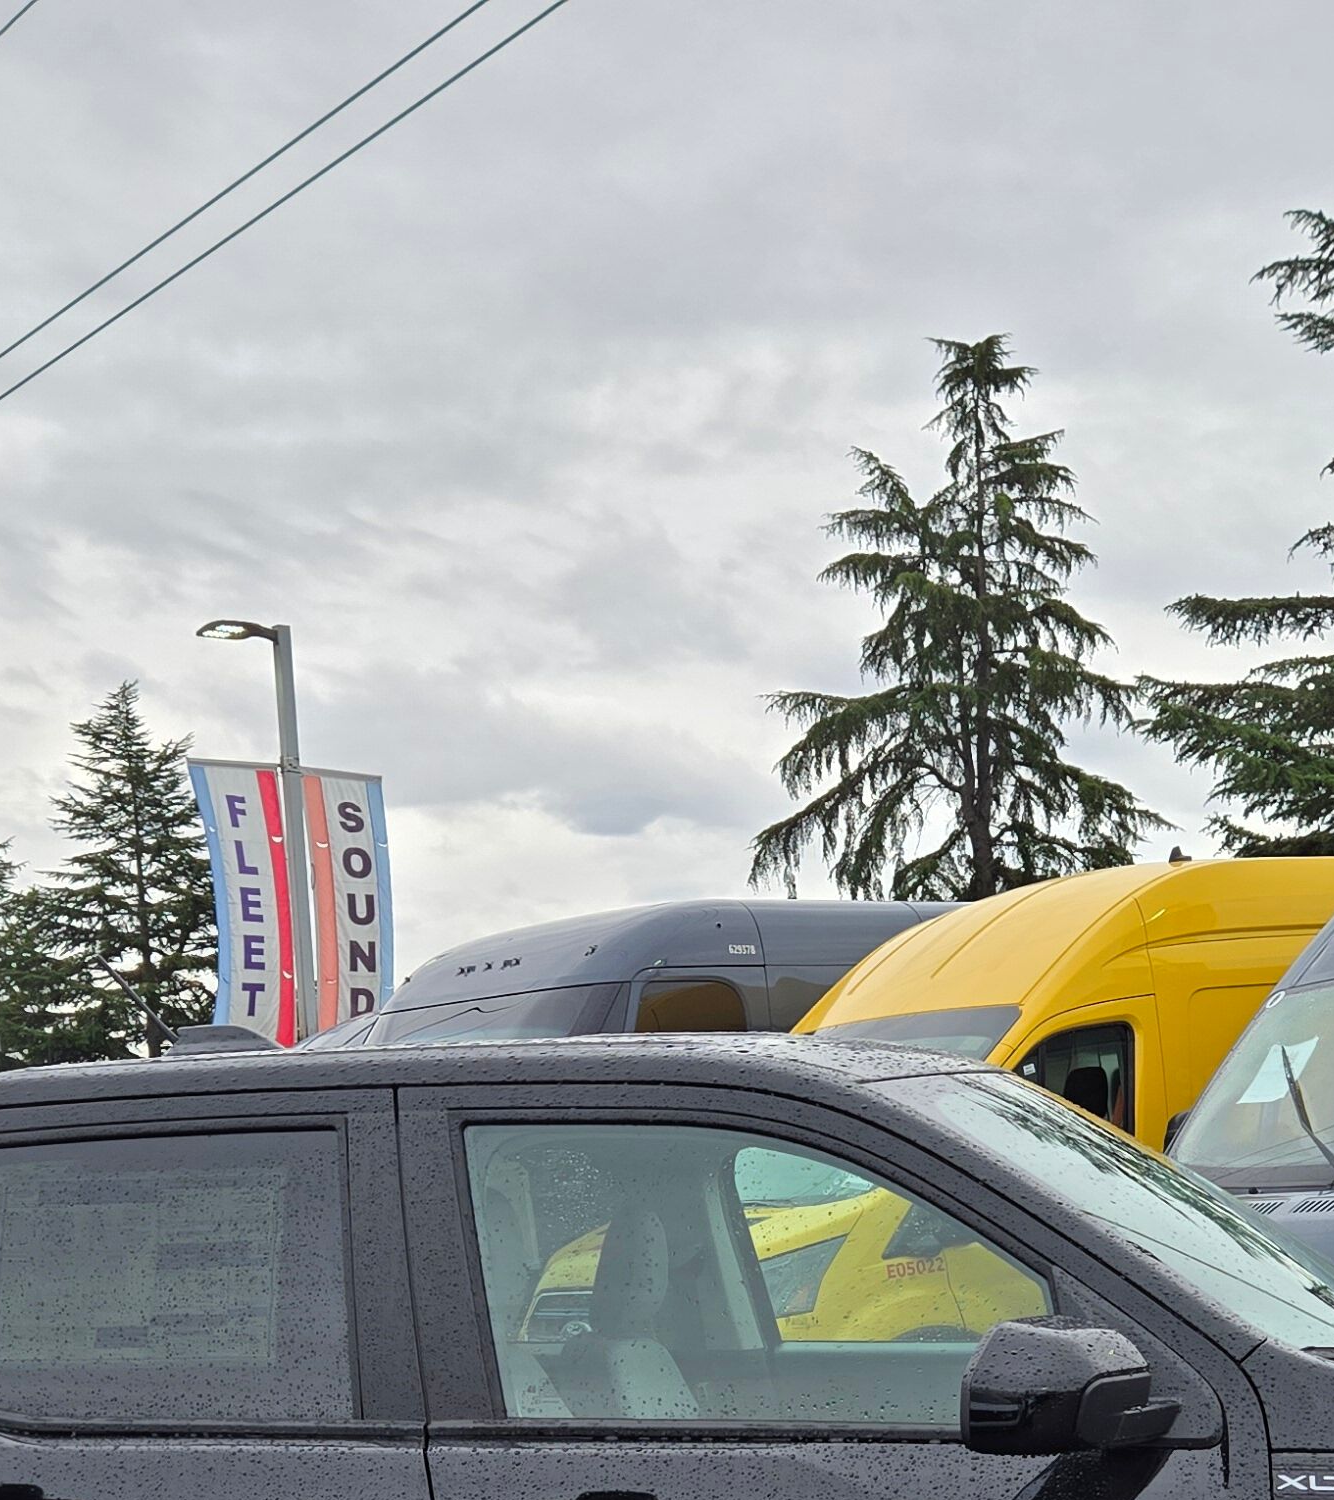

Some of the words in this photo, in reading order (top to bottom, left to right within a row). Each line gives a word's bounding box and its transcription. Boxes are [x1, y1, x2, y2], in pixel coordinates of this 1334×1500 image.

[225, 794, 266, 1017] FLEET
[336, 801, 377, 1019] SOUND
[886, 1256, 946, 1279] E05022
